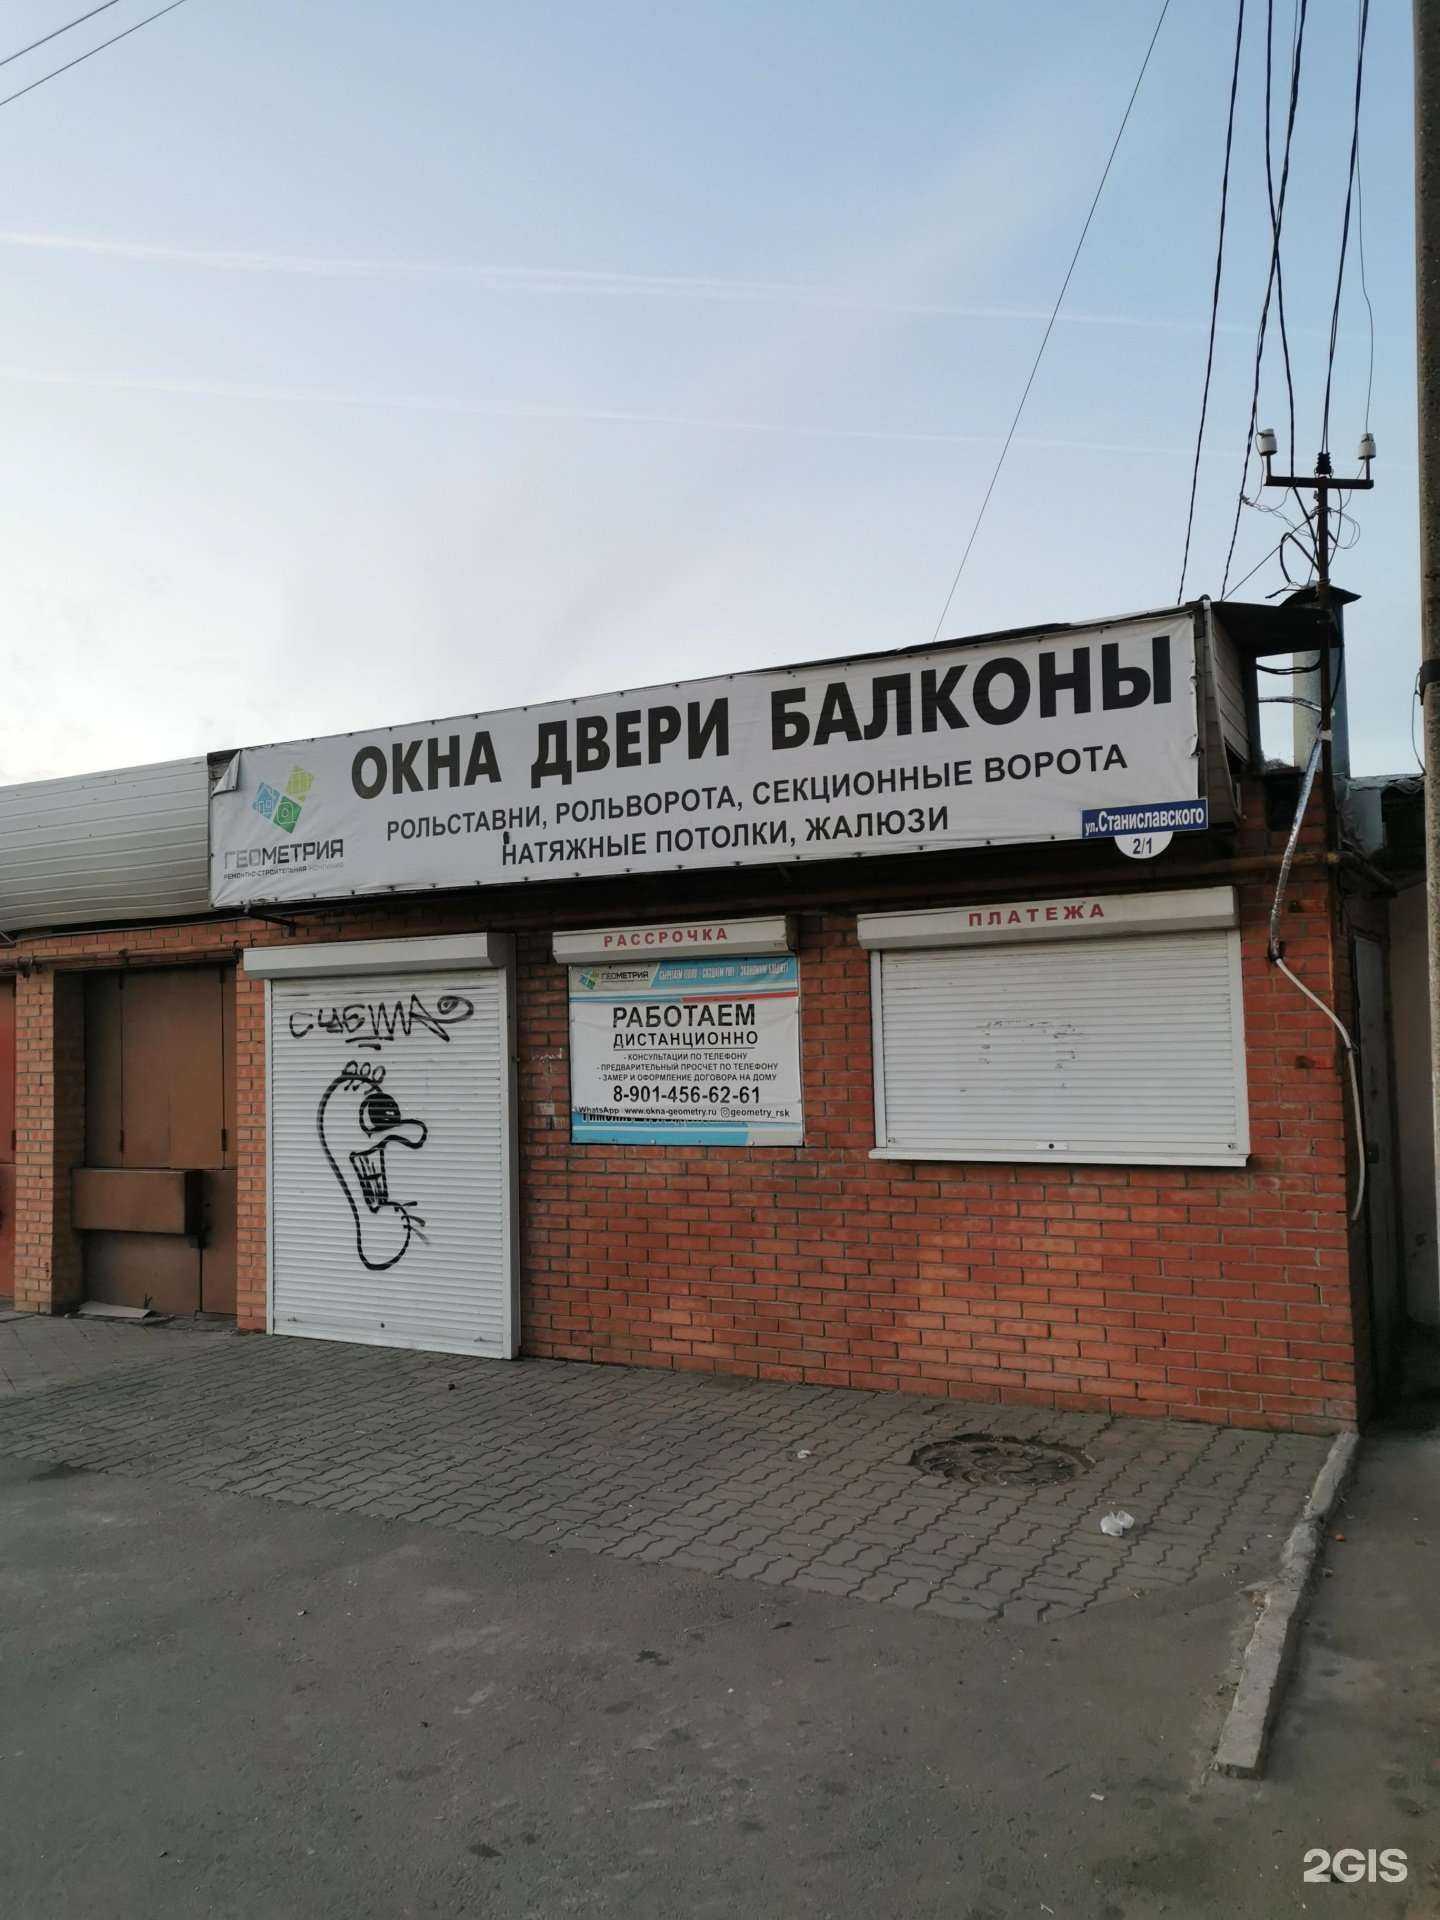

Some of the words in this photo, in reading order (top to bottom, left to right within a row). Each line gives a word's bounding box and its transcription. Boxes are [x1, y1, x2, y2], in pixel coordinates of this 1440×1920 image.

[351, 731, 502, 800] ОКНА
[530, 697, 730, 789] ДВЕРИ
[770, 635, 1172, 751] БАЛКОНЫ
[387, 805, 547, 841] РОЛЬСТАВНИ,
[556, 785, 742, 825] РОЛЬВОРОТА,
[752, 760, 973, 805] СЕКЦИОННЫЕ
[984, 743, 1128, 784] ВОРОТА
[502, 831, 647, 866] НАТЯЖНЫЕ
[656, 820, 797, 853] ПОТОЛКИ,
[805, 806, 949, 842] ЖАЛЮЗИ
[1132, 837, 1153, 855] 2/1
[224, 838, 344, 870] ГЕОМЕТРИЯ
[968, 903, 1104, 927] ПЛАТЕЖА
[603, 927, 728, 948] РАССРОЧКА
[612, 1003, 756, 1029] РАБОТАЕМ
[613, 1031, 759, 1049] ДИСТАНЦИОННО
[681, 1062, 718, 1071] ПРОСЧЕТ
[719, 1062, 732, 1071] ПО
[734, 1061, 779, 1071] ТЕЛЕФОНУ
[690, 1052, 702, 1060] ПО
[703, 1052, 748, 1061] ТЕЛЕФОНУ
[630, 1073, 636, 1081] И
[637, 1073, 692, 1081] ОФОРМЛЕНИЕ
[693, 1072, 737, 1082] ДОГОВОРА
[739, 1073, 751, 1081] НА
[752, 1073, 778, 1082] ДОМУ
[612, 1085, 761, 1105] 8-901-456-62-61
[579, 1105, 620, 1115] WhatsApp
[624, 1107, 717, 1117] www.okna-geometry.ru
